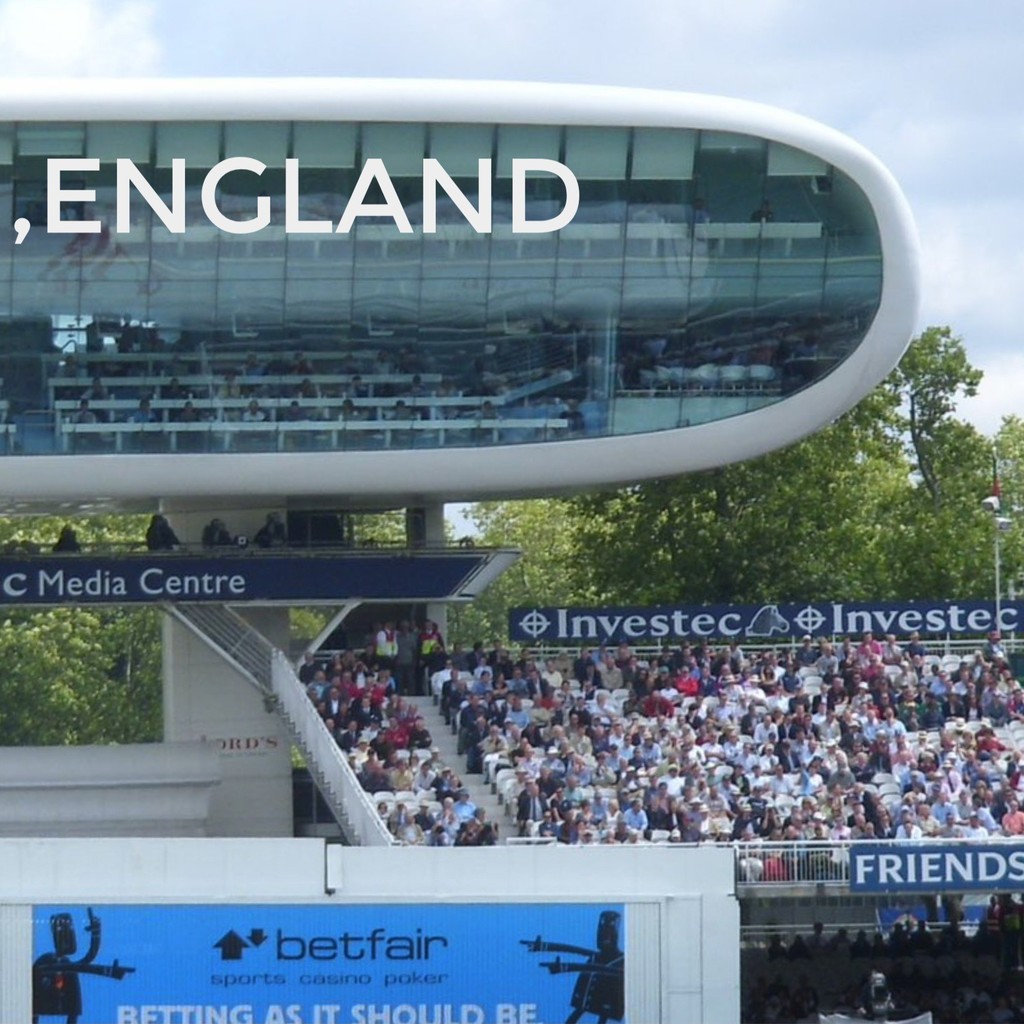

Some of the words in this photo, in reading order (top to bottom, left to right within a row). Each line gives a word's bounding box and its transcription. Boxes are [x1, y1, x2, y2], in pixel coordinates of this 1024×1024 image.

[39, 571, 126, 595] Media
[140, 569, 246, 594] Centre
[557, 609, 741, 638] Investec
[833, 604, 1017, 632] Investec
[856, 852, 1024, 884] FRIENDS
[277, 928, 448, 961] betfair
[211, 972, 286, 987] sports
[299, 972, 372, 985] casino
[385, 971, 449, 987] poker
[117, 1005, 253, 1024] BETTING
[265, 1005, 301, 1024] AS
[314, 1004, 340, 1024] IT
[351, 1004, 485, 1024] SHOULD
